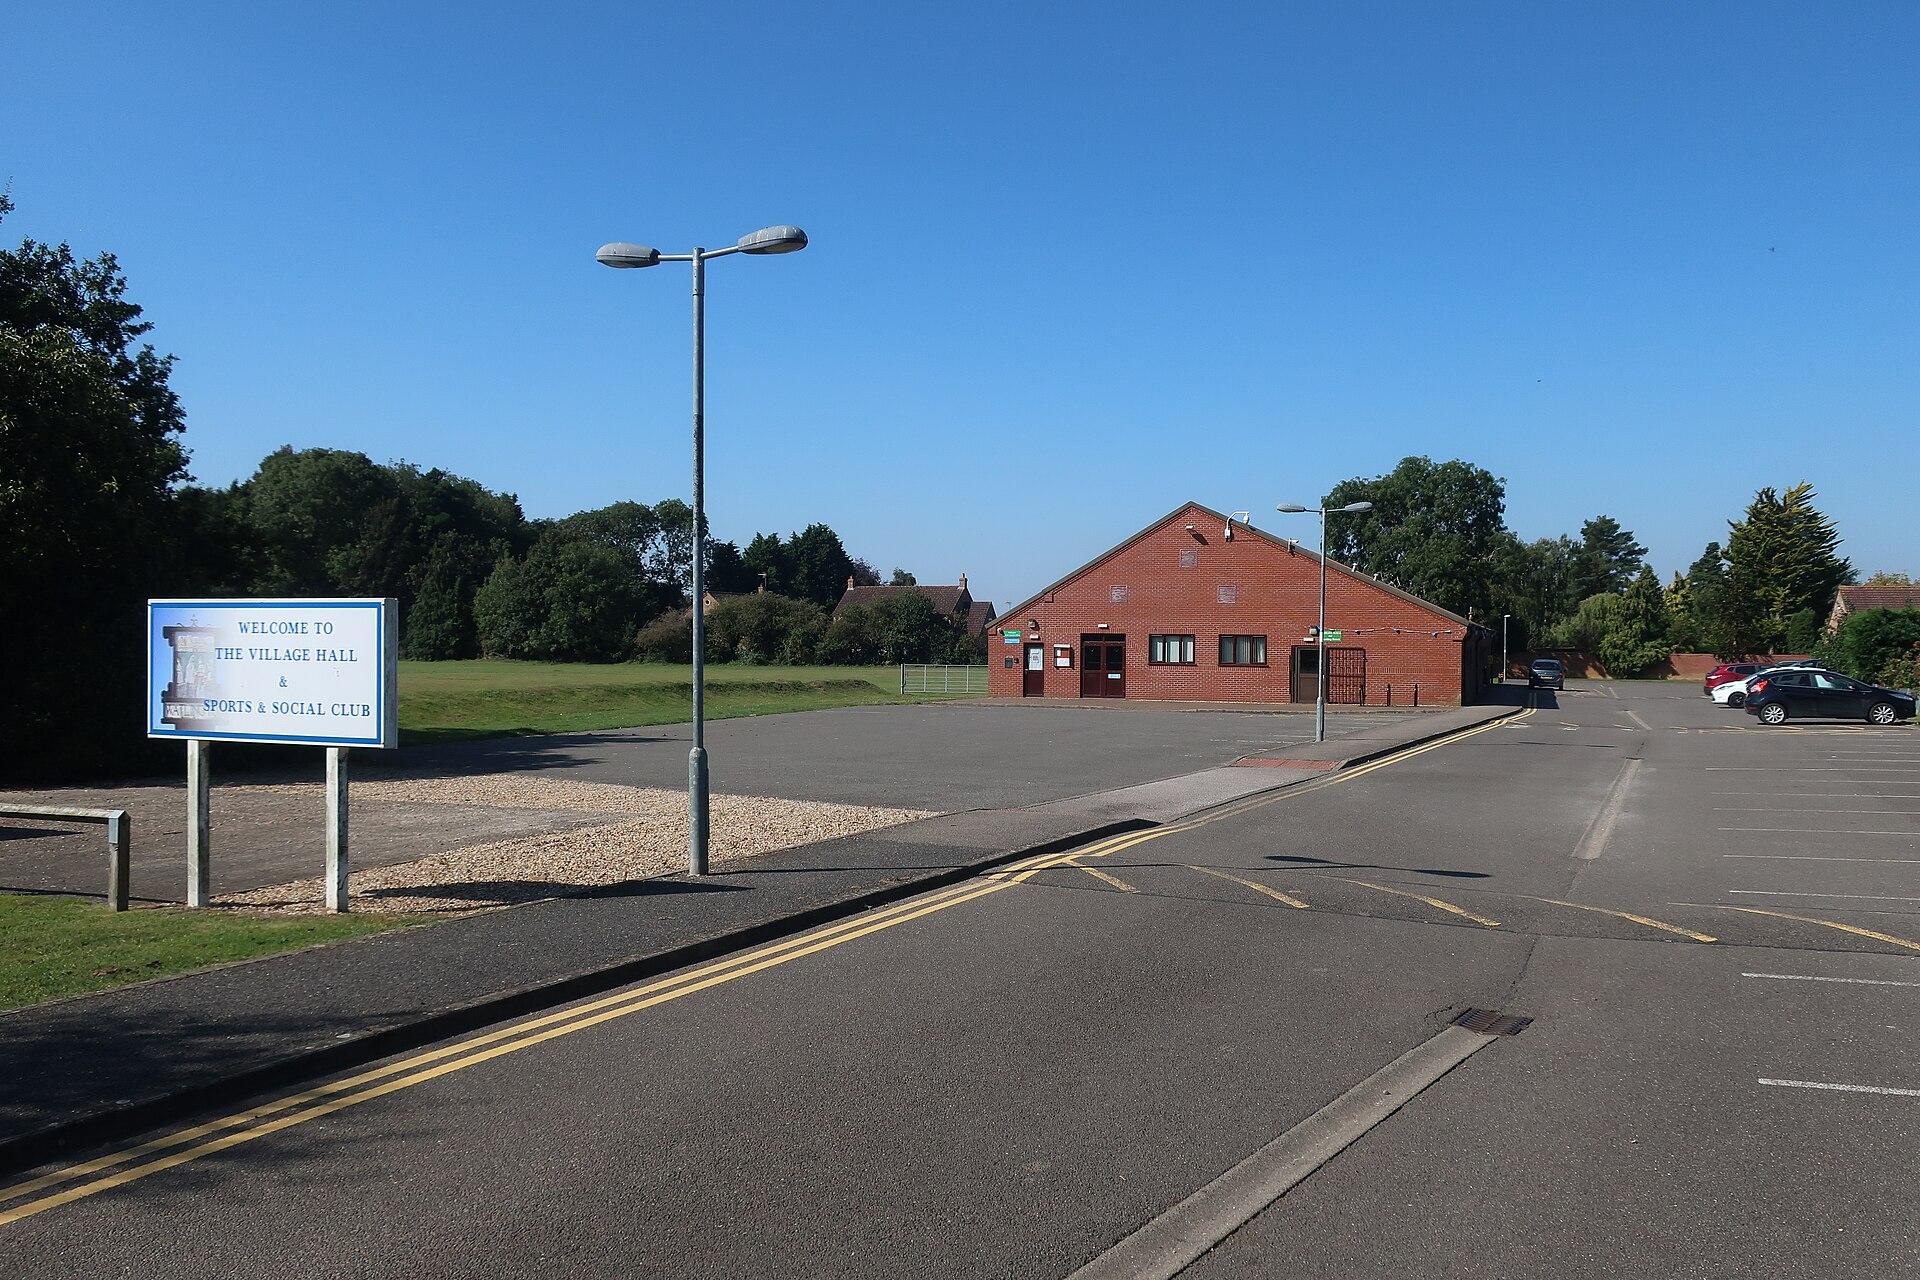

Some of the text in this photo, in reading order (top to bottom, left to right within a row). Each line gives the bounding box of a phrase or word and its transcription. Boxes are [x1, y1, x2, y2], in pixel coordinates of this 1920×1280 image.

[238, 621, 333, 635] WELCOME TO
[215, 647, 358, 662] THE VILLAGE HALL
[279, 675, 288, 687] &
[203, 699, 371, 717] SPORTS & SOCIAL CLUB
